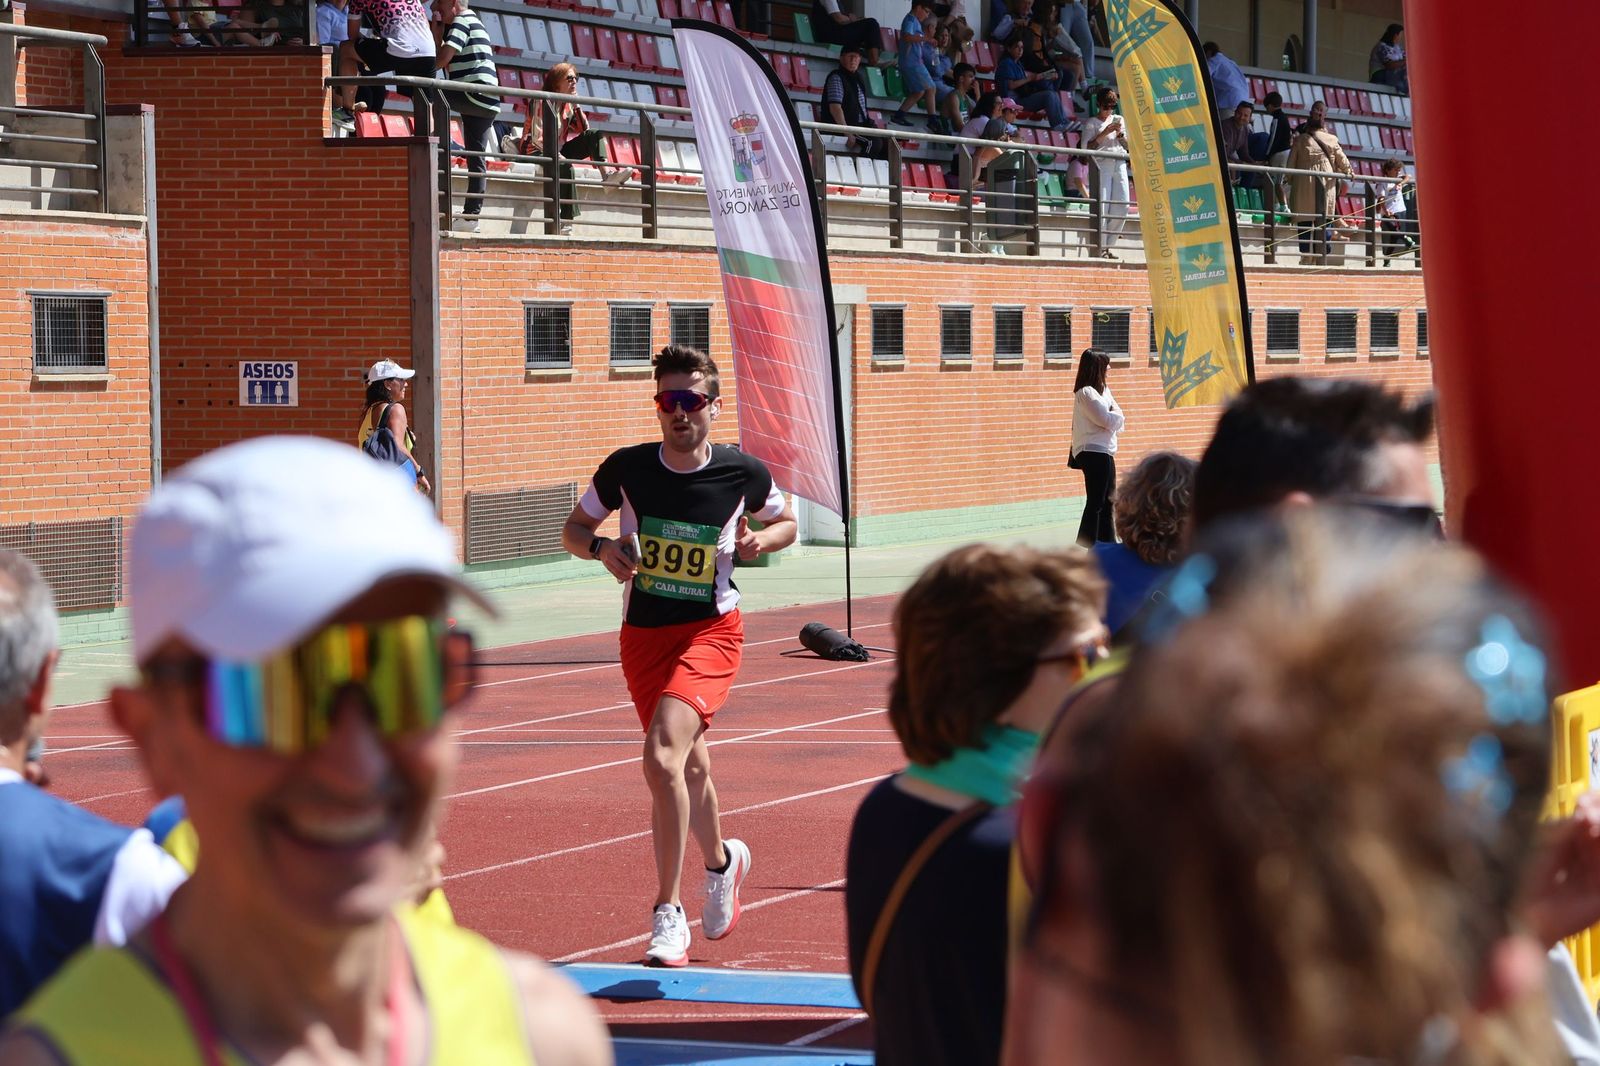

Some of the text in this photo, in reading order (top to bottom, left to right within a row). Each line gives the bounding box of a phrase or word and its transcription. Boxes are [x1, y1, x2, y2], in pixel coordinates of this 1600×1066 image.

[243, 363, 294, 379] ASEOS
[642, 539, 705, 577] 399
[678, 585, 708, 597] RURAL
